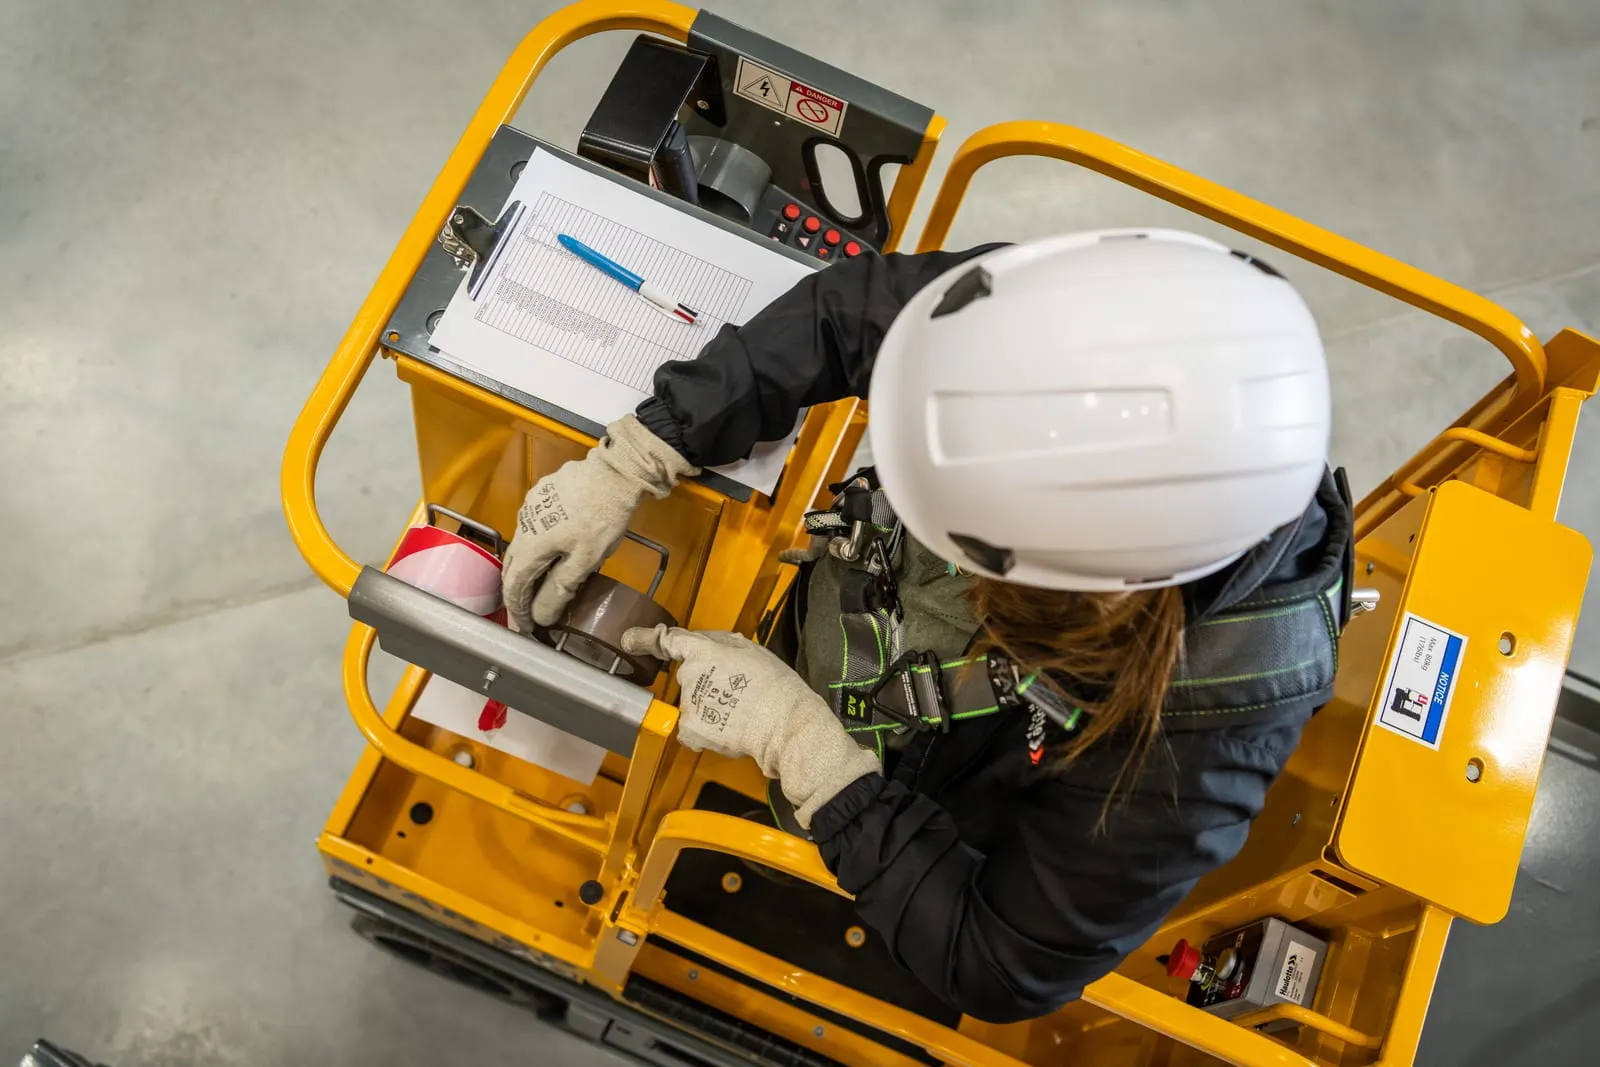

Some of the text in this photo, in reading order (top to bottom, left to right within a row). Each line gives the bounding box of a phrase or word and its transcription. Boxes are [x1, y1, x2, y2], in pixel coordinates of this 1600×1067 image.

[806, 90, 838, 108] DANGER
[1421, 653, 1432, 671] 80kg
[718, 690, 733, 706] CE
[1434, 672, 1449, 705] NOTICE
[847, 694, 857, 716] A/2
[1279, 966, 1293, 995] Haulotte
